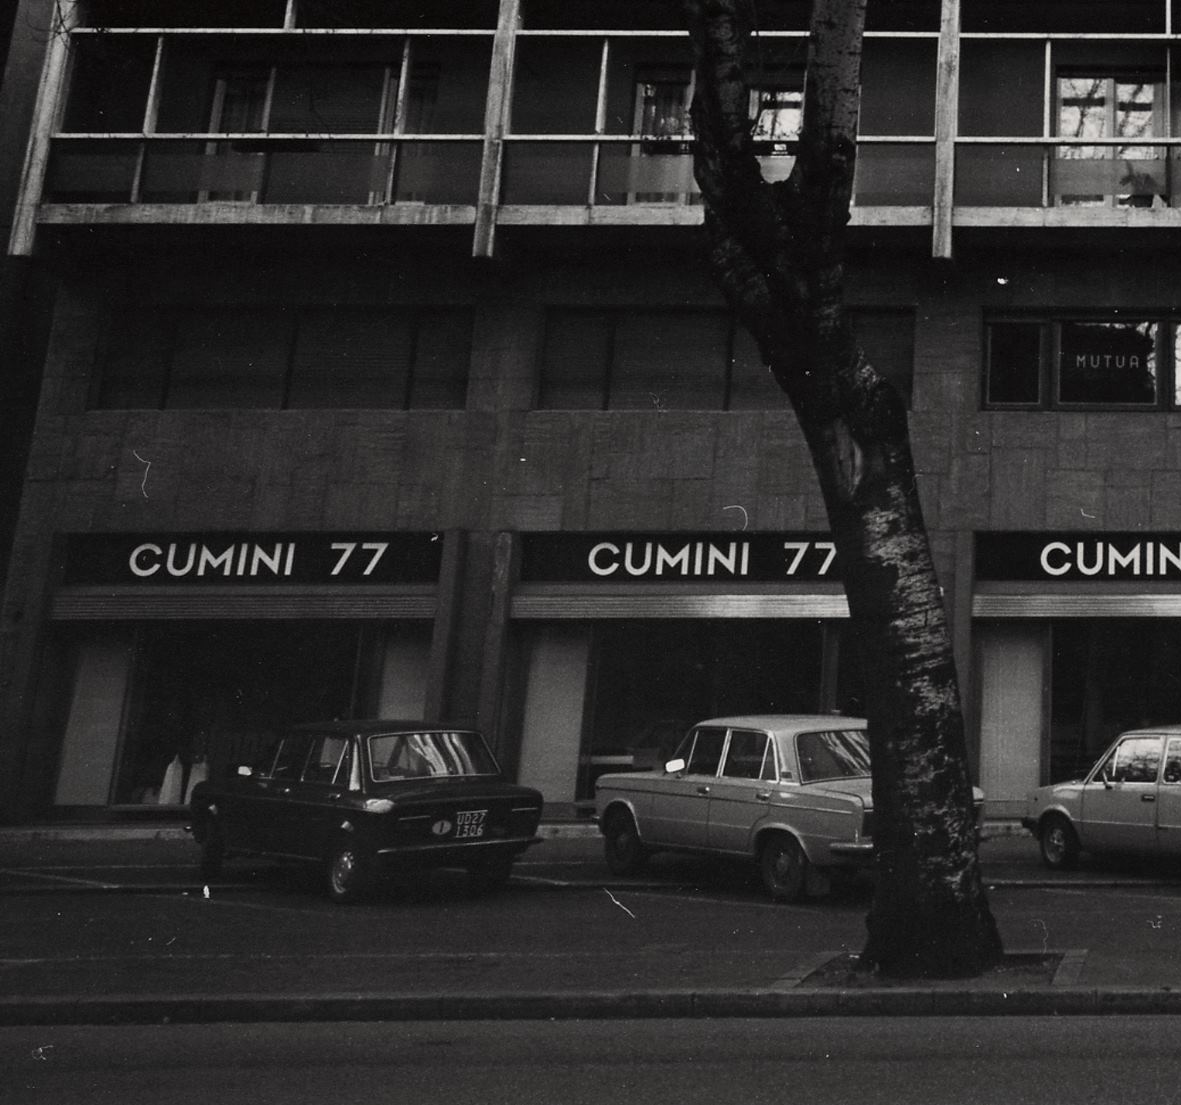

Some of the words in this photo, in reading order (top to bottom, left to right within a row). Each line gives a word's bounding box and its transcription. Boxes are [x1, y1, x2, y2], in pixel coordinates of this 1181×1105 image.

[1076, 354, 1140, 369] MUTUA
[129, 542, 296, 577] CUMINI
[330, 542, 389, 576] 77
[587, 542, 750, 576] CUMINI
[783, 541, 837, 575] 77
